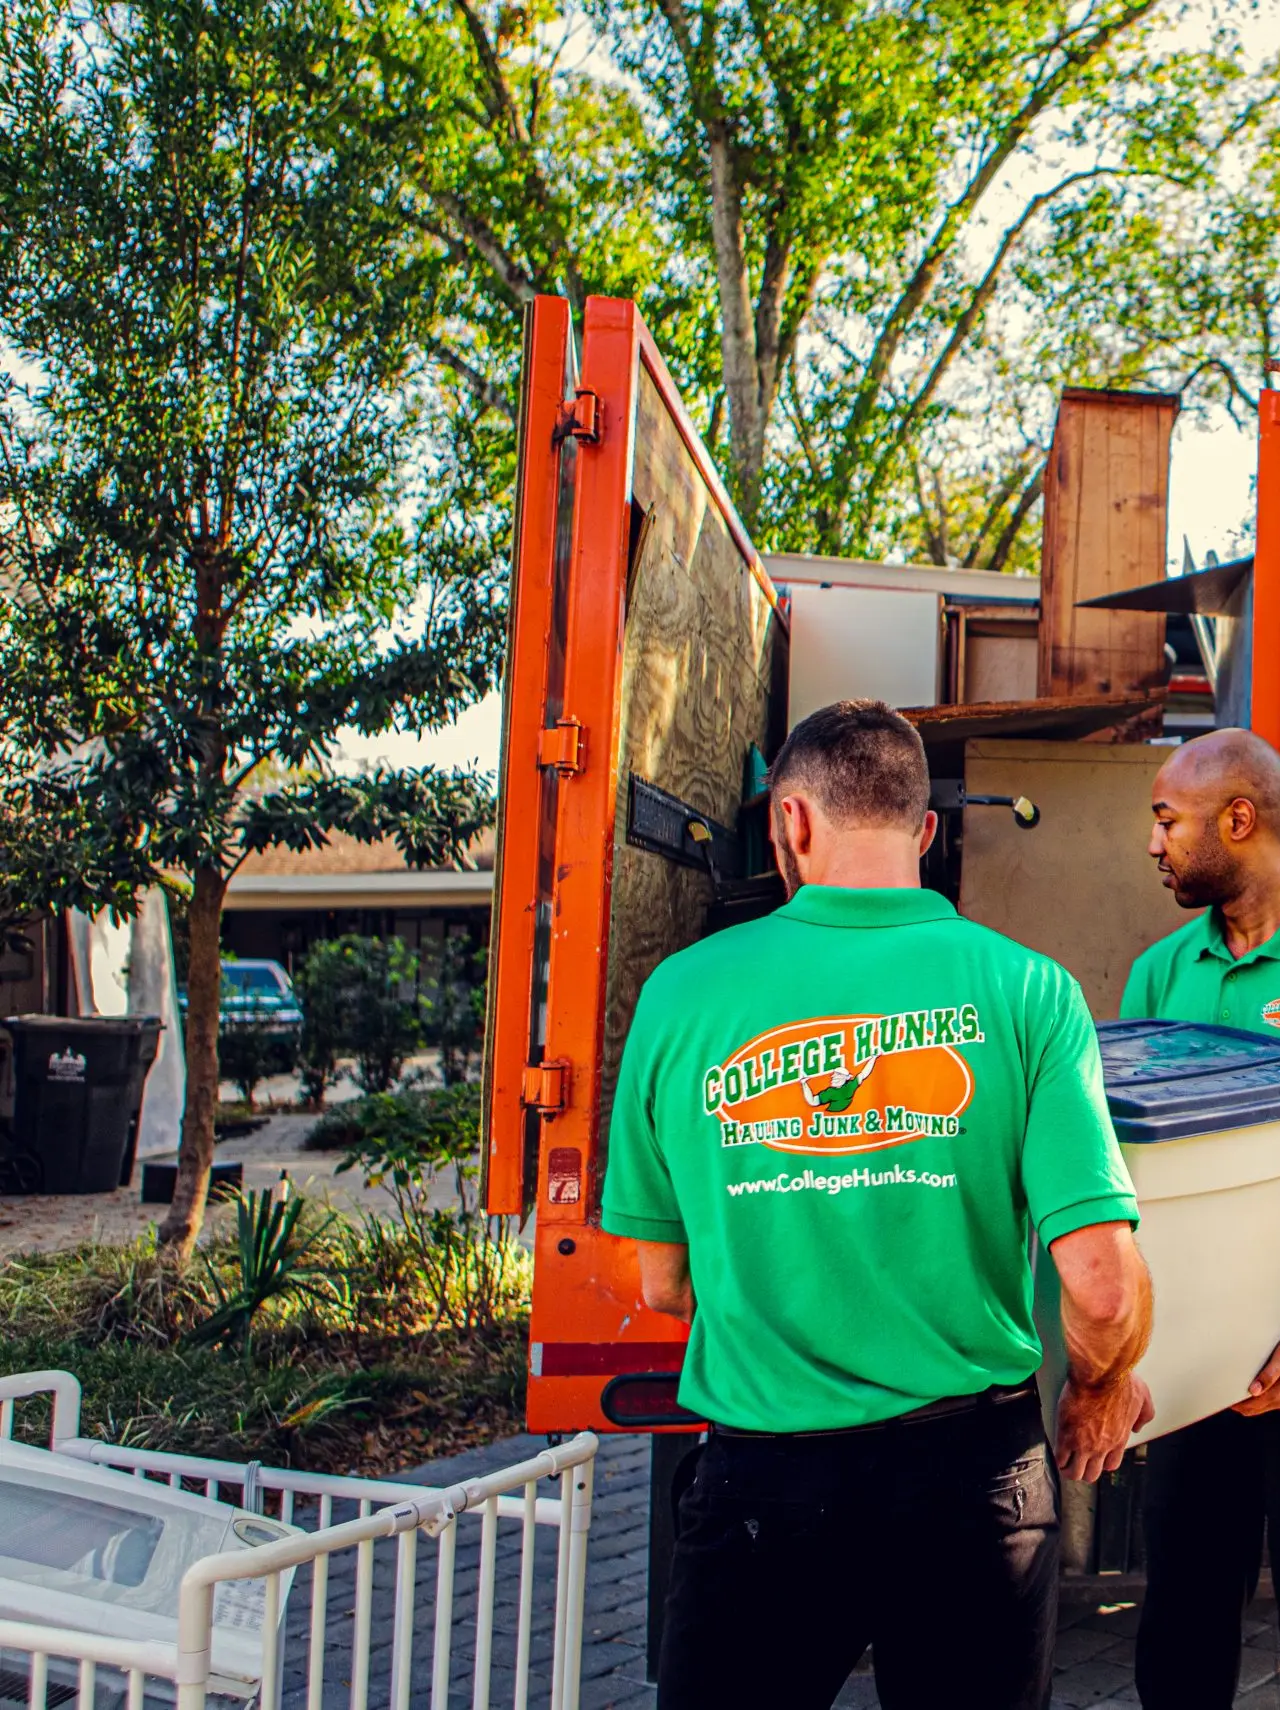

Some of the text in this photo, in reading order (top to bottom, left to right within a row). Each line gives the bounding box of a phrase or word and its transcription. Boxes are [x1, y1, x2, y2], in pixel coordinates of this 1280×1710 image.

[702, 1003, 985, 1115] COLLEGE H.U.N.K.S.
[808, 1111, 861, 1137] JUNK
[864, 1109, 884, 1134] &
[726, 1163, 958, 1196] www.CollegeHunks.com
